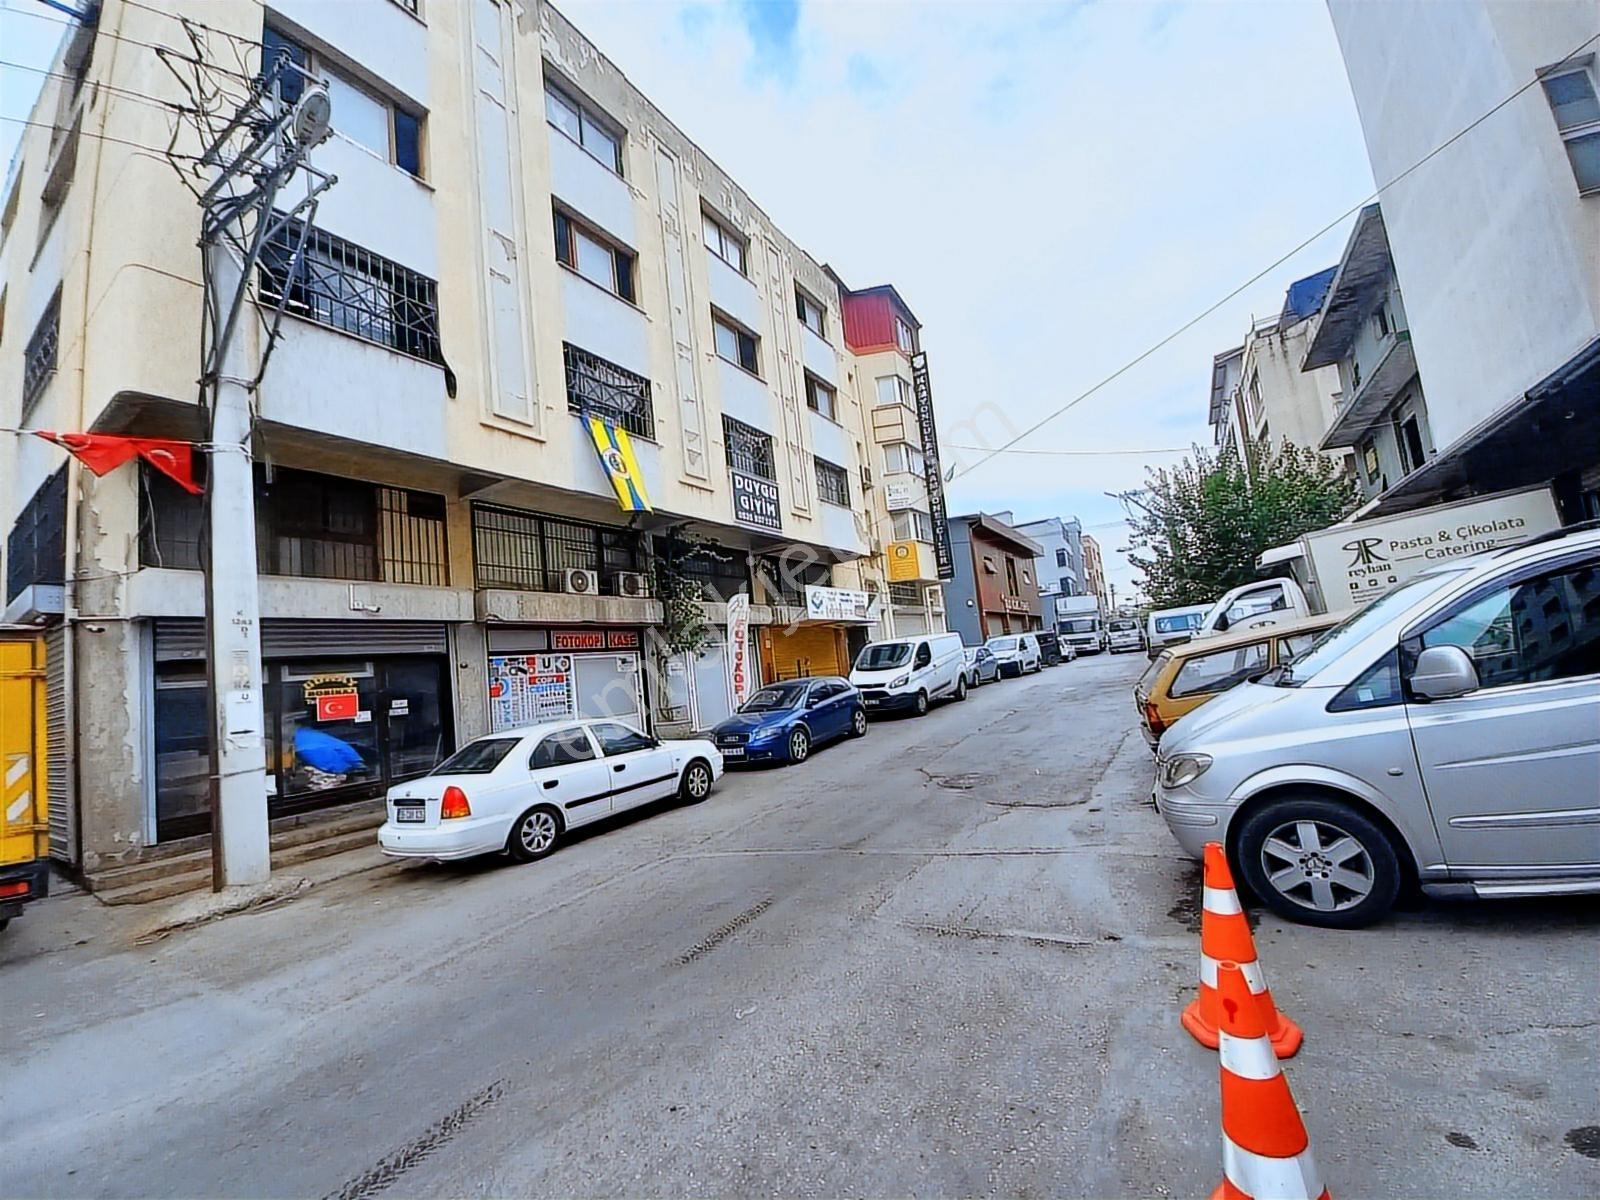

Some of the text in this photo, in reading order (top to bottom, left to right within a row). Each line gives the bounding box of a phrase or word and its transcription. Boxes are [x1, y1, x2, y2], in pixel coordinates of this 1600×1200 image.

[735, 475, 777, 500] DUYGU
[1389, 517, 1526, 552] Pasta & Çikolata
[1424, 538, 1497, 560] Catering
[1348, 563, 1392, 578] reyhan
